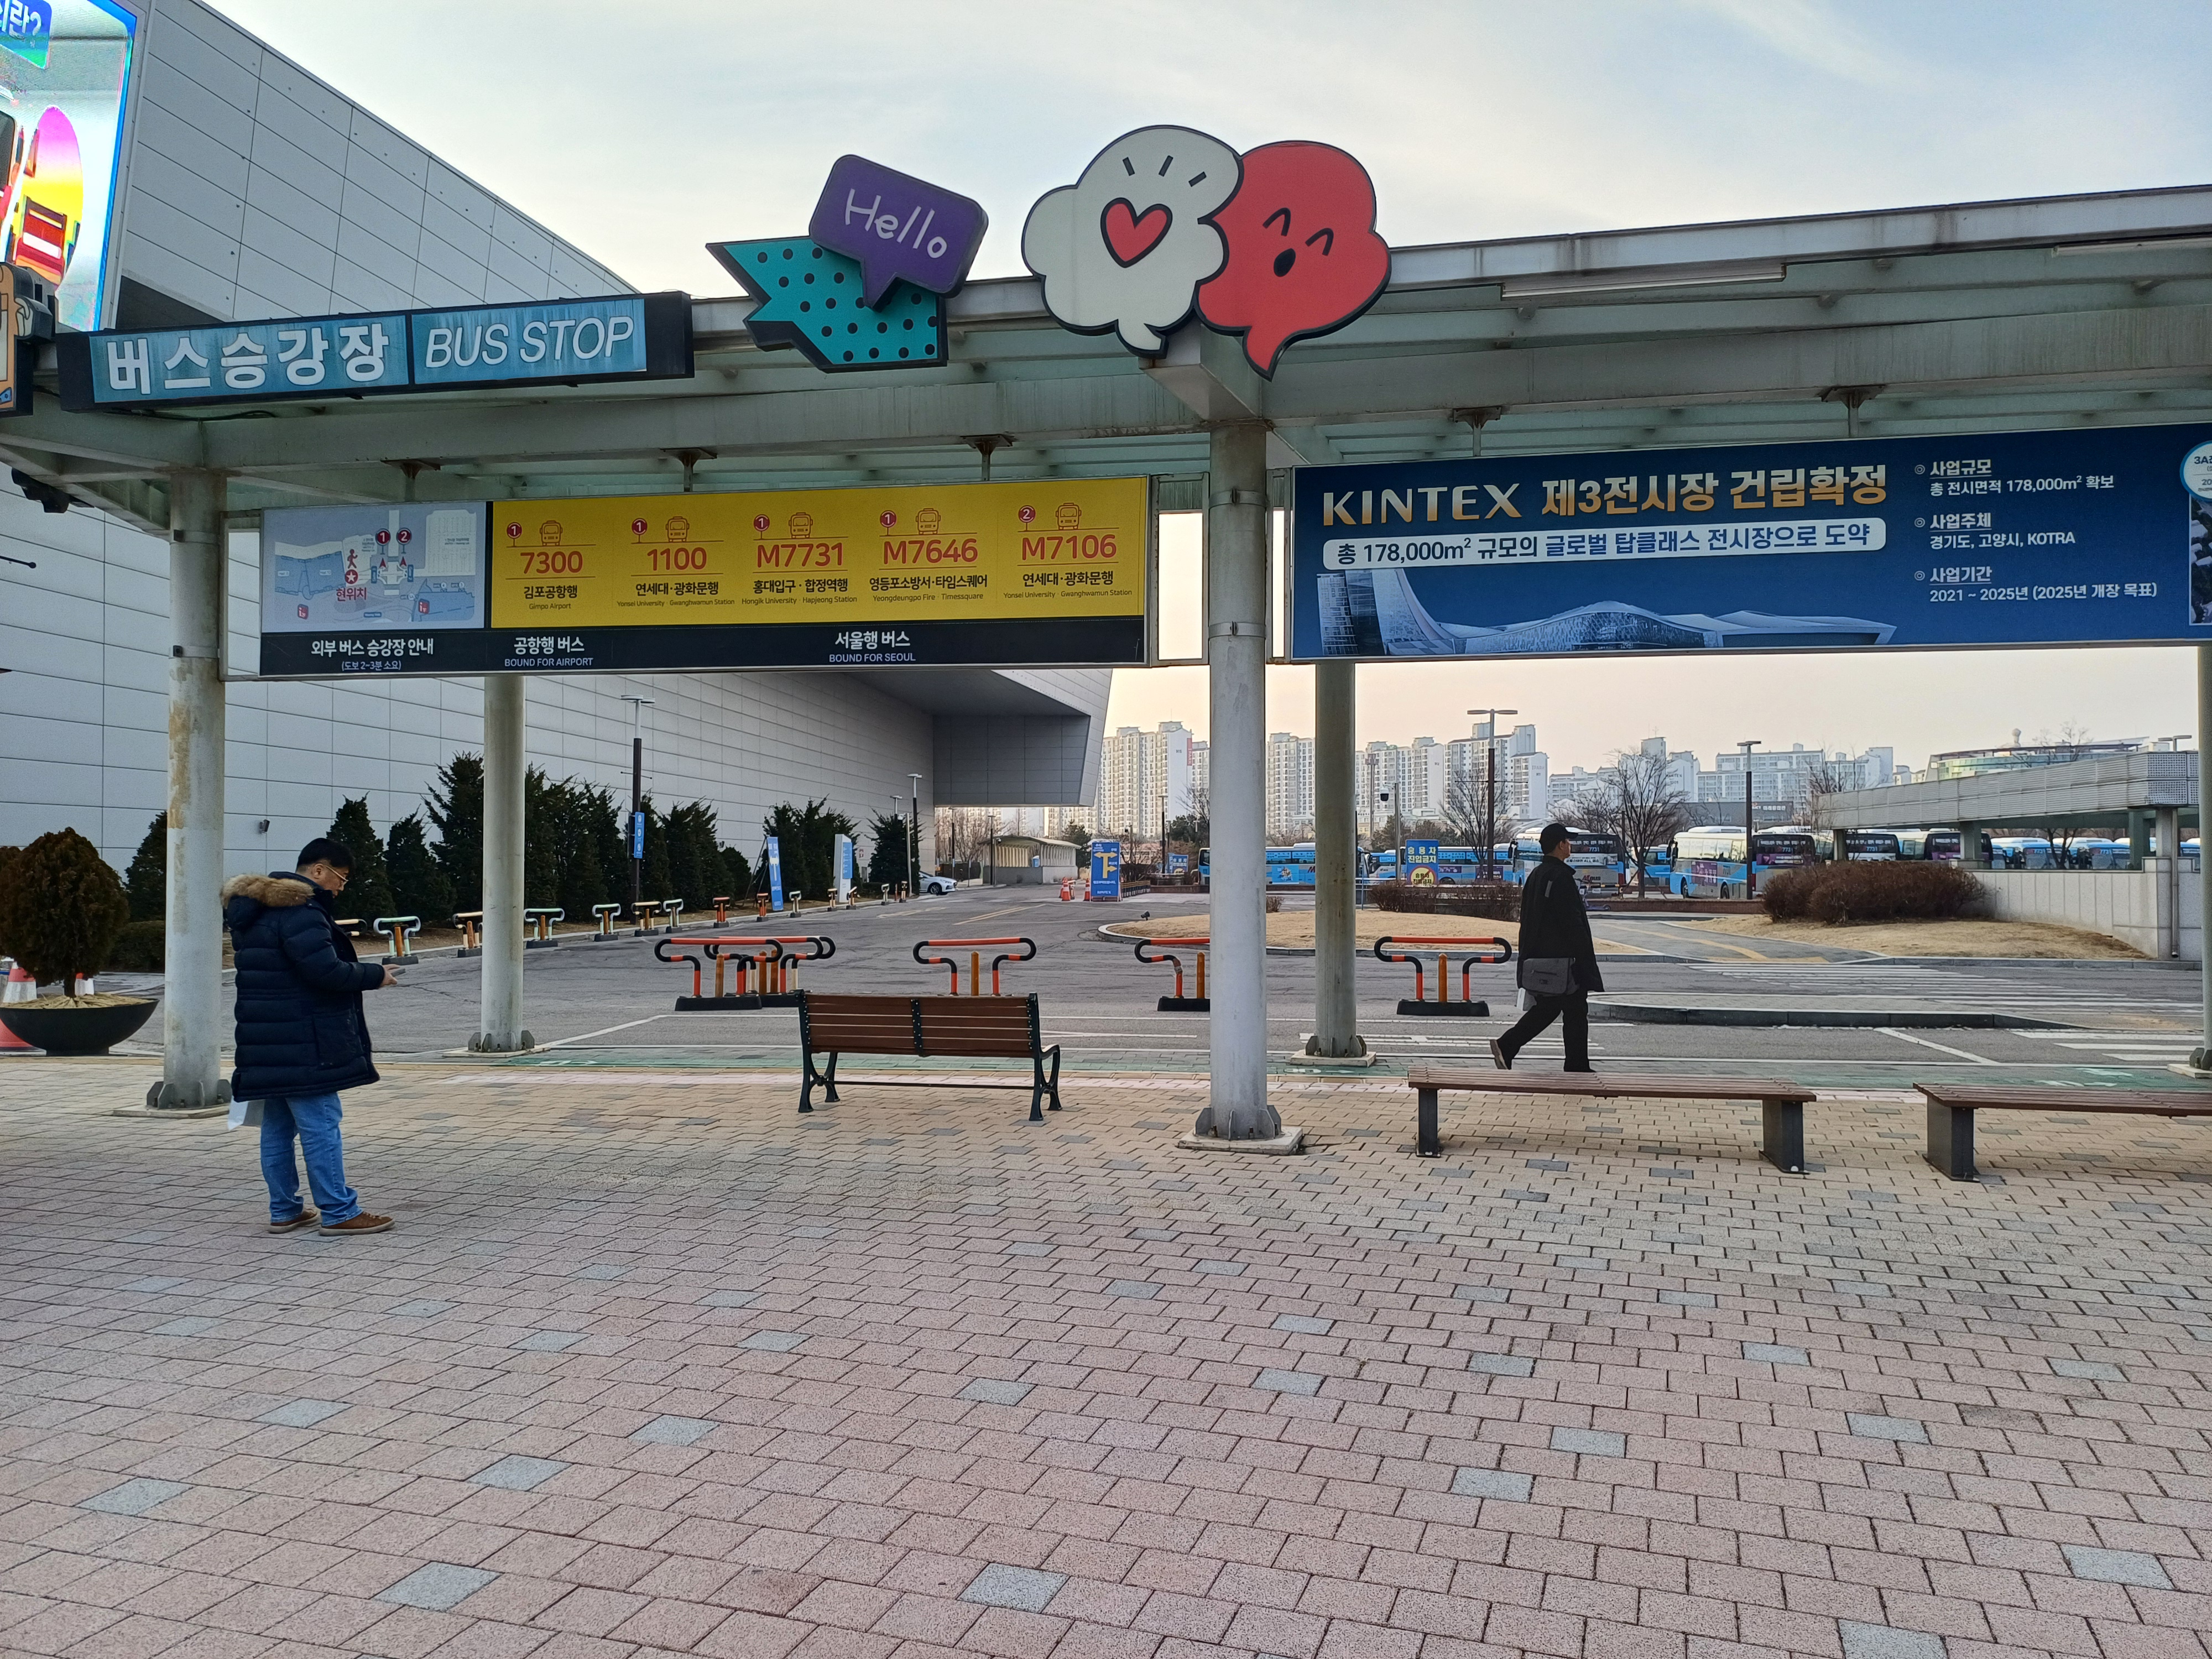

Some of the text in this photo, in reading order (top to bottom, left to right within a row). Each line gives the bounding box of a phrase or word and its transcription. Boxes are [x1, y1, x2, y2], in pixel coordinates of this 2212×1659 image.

[845, 189, 947, 258] Hello
[425, 316, 634, 368] BUS STOP
[107, 323, 390, 394] 버스승강장
[1930, 459, 1992, 477] 사업규모
[1323, 465, 1886, 526] KINTEX 제3전시장 건립확정
[1930, 483, 1944, 497] 총
[1947, 480, 2002, 496] 전시면적
[2086, 475, 2114, 489] 확보
[1930, 513, 1992, 529] 사업주체
[1022, 534, 1117, 561] M7106
[1337, 543, 1357, 565] 총
[1478, 536, 1537, 560] 규모의
[1546, 533, 1607, 555] 글로벌
[1615, 531, 1700, 554] 탑클래스
[1708, 525, 1818, 551] 전시장으로
[1825, 523, 1870, 546] 도약
[1930, 531, 2076, 550] 경기도, 고양시, KOTRA
[646, 547, 707, 571] 1100
[757, 542, 843, 568] M7731
[884, 539, 978, 565] M7646
[520, 551, 583, 574] 7300
[1930, 566, 1992, 583] 사업기간
[336, 587, 367, 602] 현위치
[523, 585, 578, 599] 김포공항행
[753, 578, 848, 594] 홍대입구 합정역행
[1930, 589, 1964, 602] 2021
[1980, 586, 2028, 601] 2025년
[2032, 585, 2087, 601] (2025년
[2091, 583, 2120, 599] 개장
[2124, 582, 2157, 598] 목표)
[669, 599, 713, 608] Gwanghwamun
[802, 597, 833, 605] Hapjeong
[873, 594, 921, 603] Yeongdeungpo
[311, 638, 434, 657] 외부 버스 승강장 안내
[514, 637, 585, 655] 공항행 버스
[835, 631, 911, 650] 서울행 버스
[341, 661, 360, 671] (도보
[504, 658, 593, 667] BOUND FOR AIRPORT
[830, 653, 916, 662] BOUND FOR SEOUL
[1407, 855, 1437, 863] 진입금지
